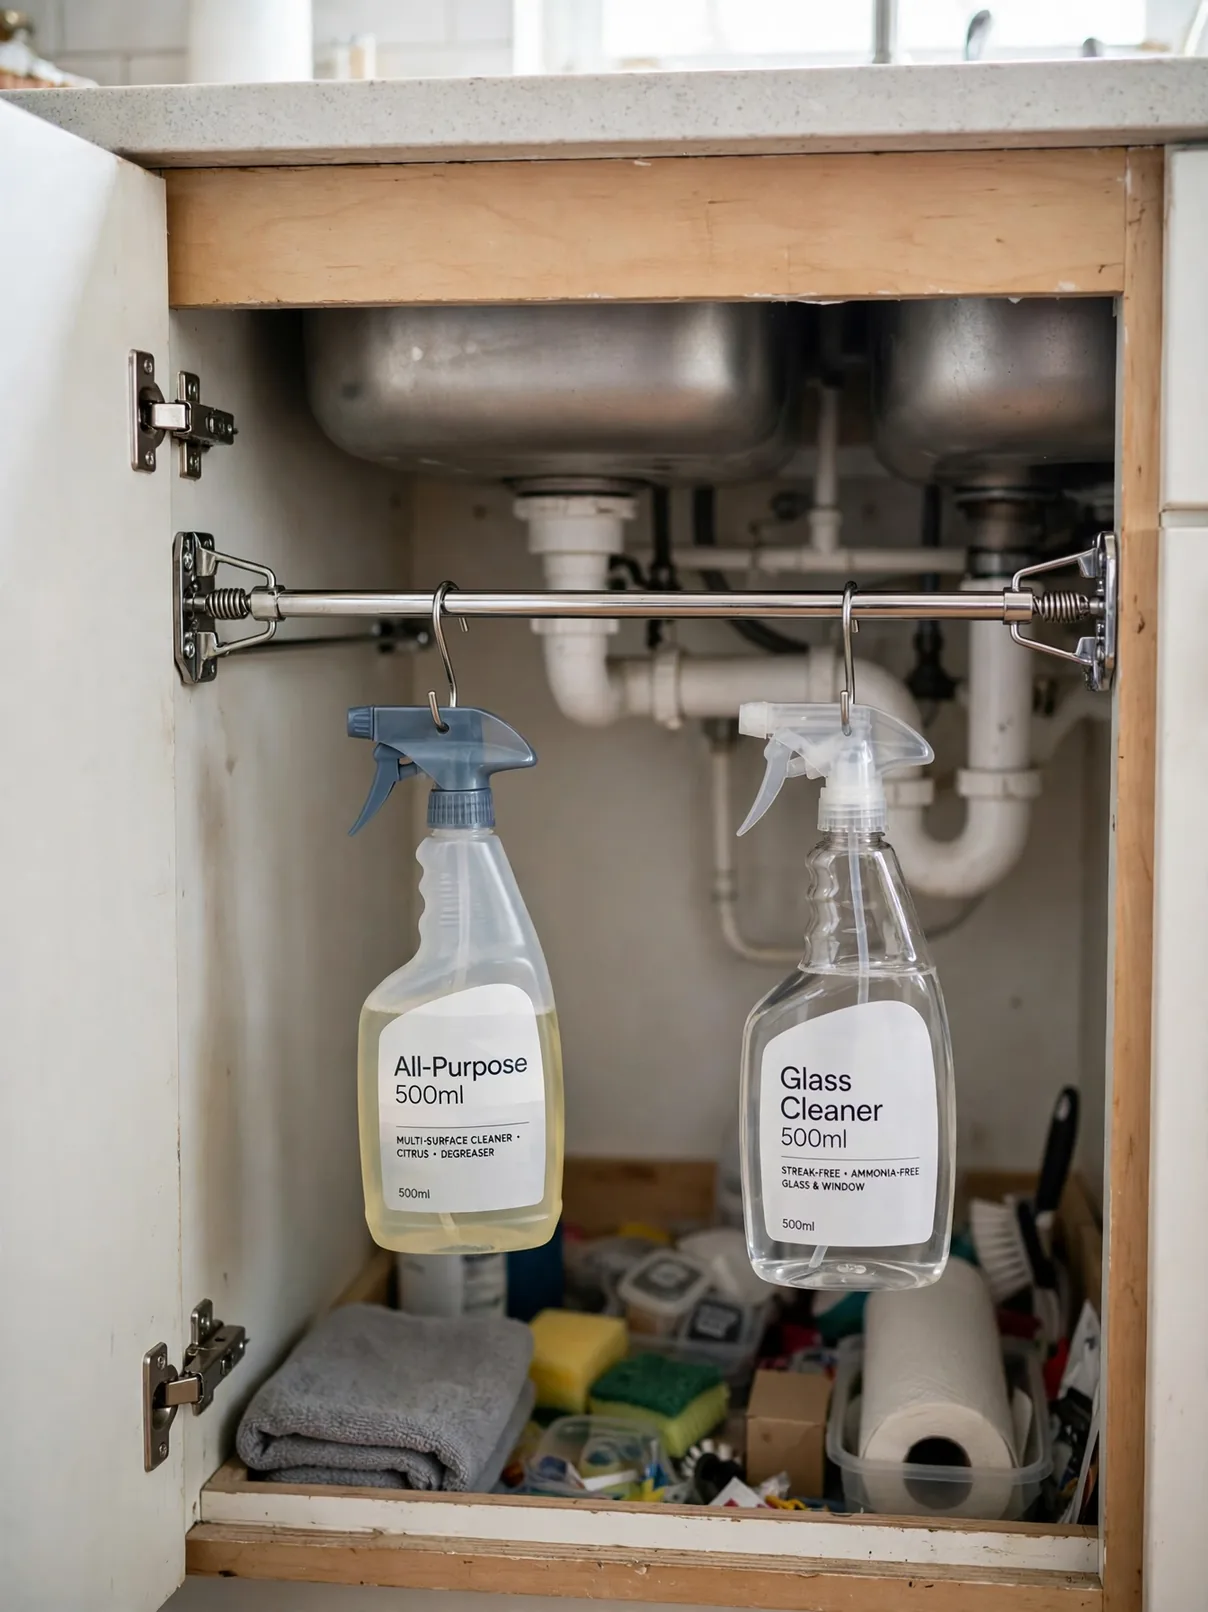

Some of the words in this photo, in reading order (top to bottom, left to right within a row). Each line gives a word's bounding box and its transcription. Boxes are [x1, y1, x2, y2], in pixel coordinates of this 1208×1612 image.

[393, 1055, 528, 1082] All-Purpose
[780, 1065, 852, 1092] Glass
[395, 1084, 464, 1105] 500ml
[780, 1095, 884, 1122] Cleaner
[396, 1135, 469, 1146] MULTI-SURFACE
[470, 1133, 513, 1145] CLEANER
[781, 1126, 847, 1149] 500ml
[396, 1148, 430, 1159] CITRUS
[440, 1147, 495, 1159] DEGREASER
[781, 1165, 841, 1179] STREAK-FREE
[850, 1166, 921, 1179] AMMONIA-FREE
[781, 1178, 811, 1190] GLASS
[812, 1180, 820, 1191] &
[821, 1181, 866, 1192] WINDOW
[398, 1187, 431, 1199] 500ml
[782, 1218, 816, 1232] 500ml
